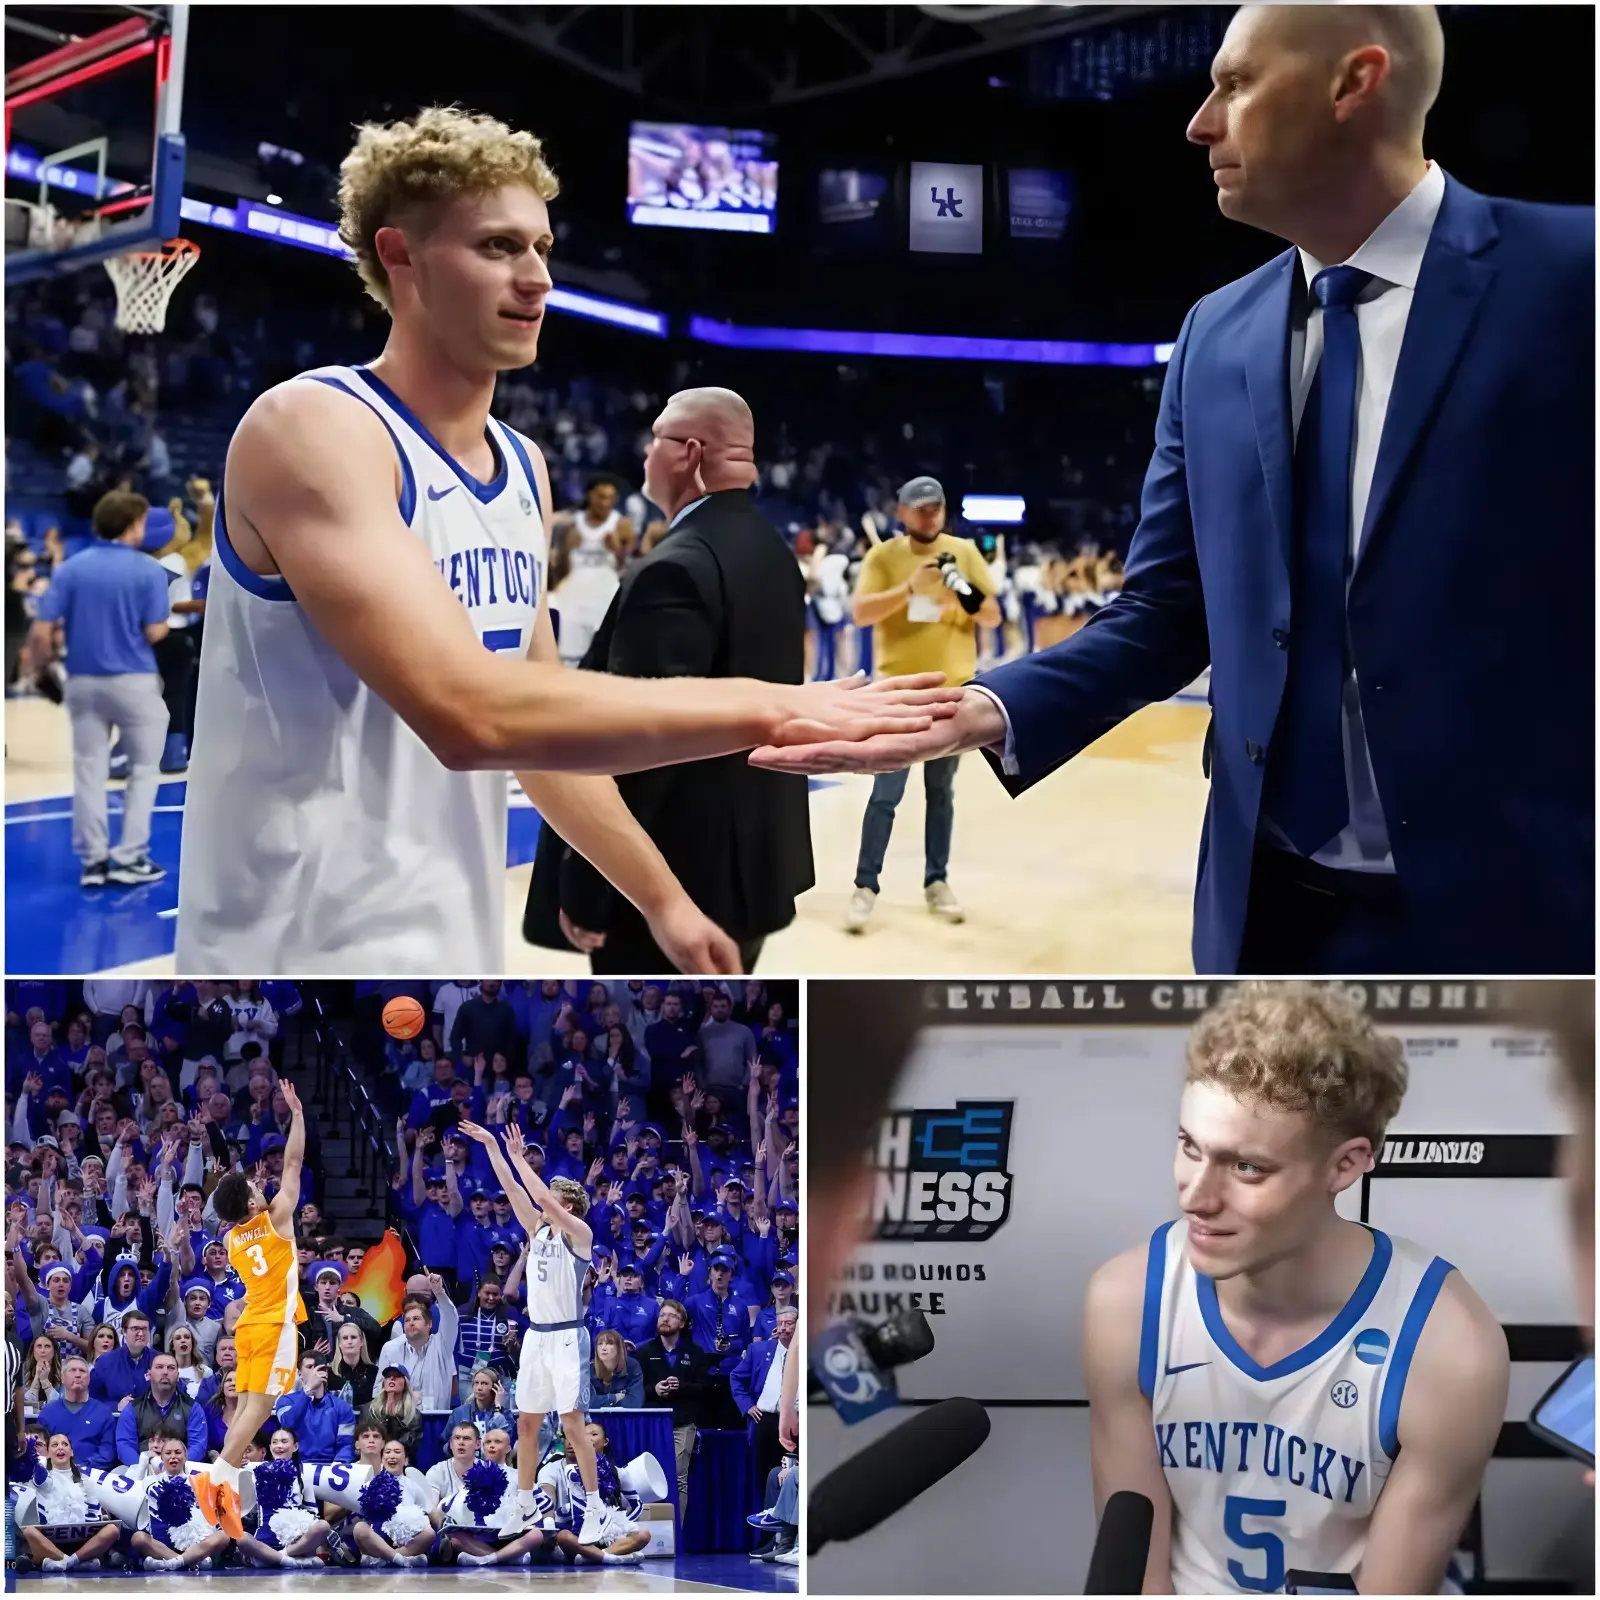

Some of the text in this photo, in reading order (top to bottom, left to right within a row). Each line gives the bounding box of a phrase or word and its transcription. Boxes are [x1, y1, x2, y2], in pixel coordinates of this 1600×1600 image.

[926, 984, 1126, 1009] ETBALL
[246, 1244, 268, 1277] 3
[537, 1260, 548, 1282] 5
[1156, 1421, 1365, 1503] KENTUCKY
[1223, 1495, 1287, 1593] 5
